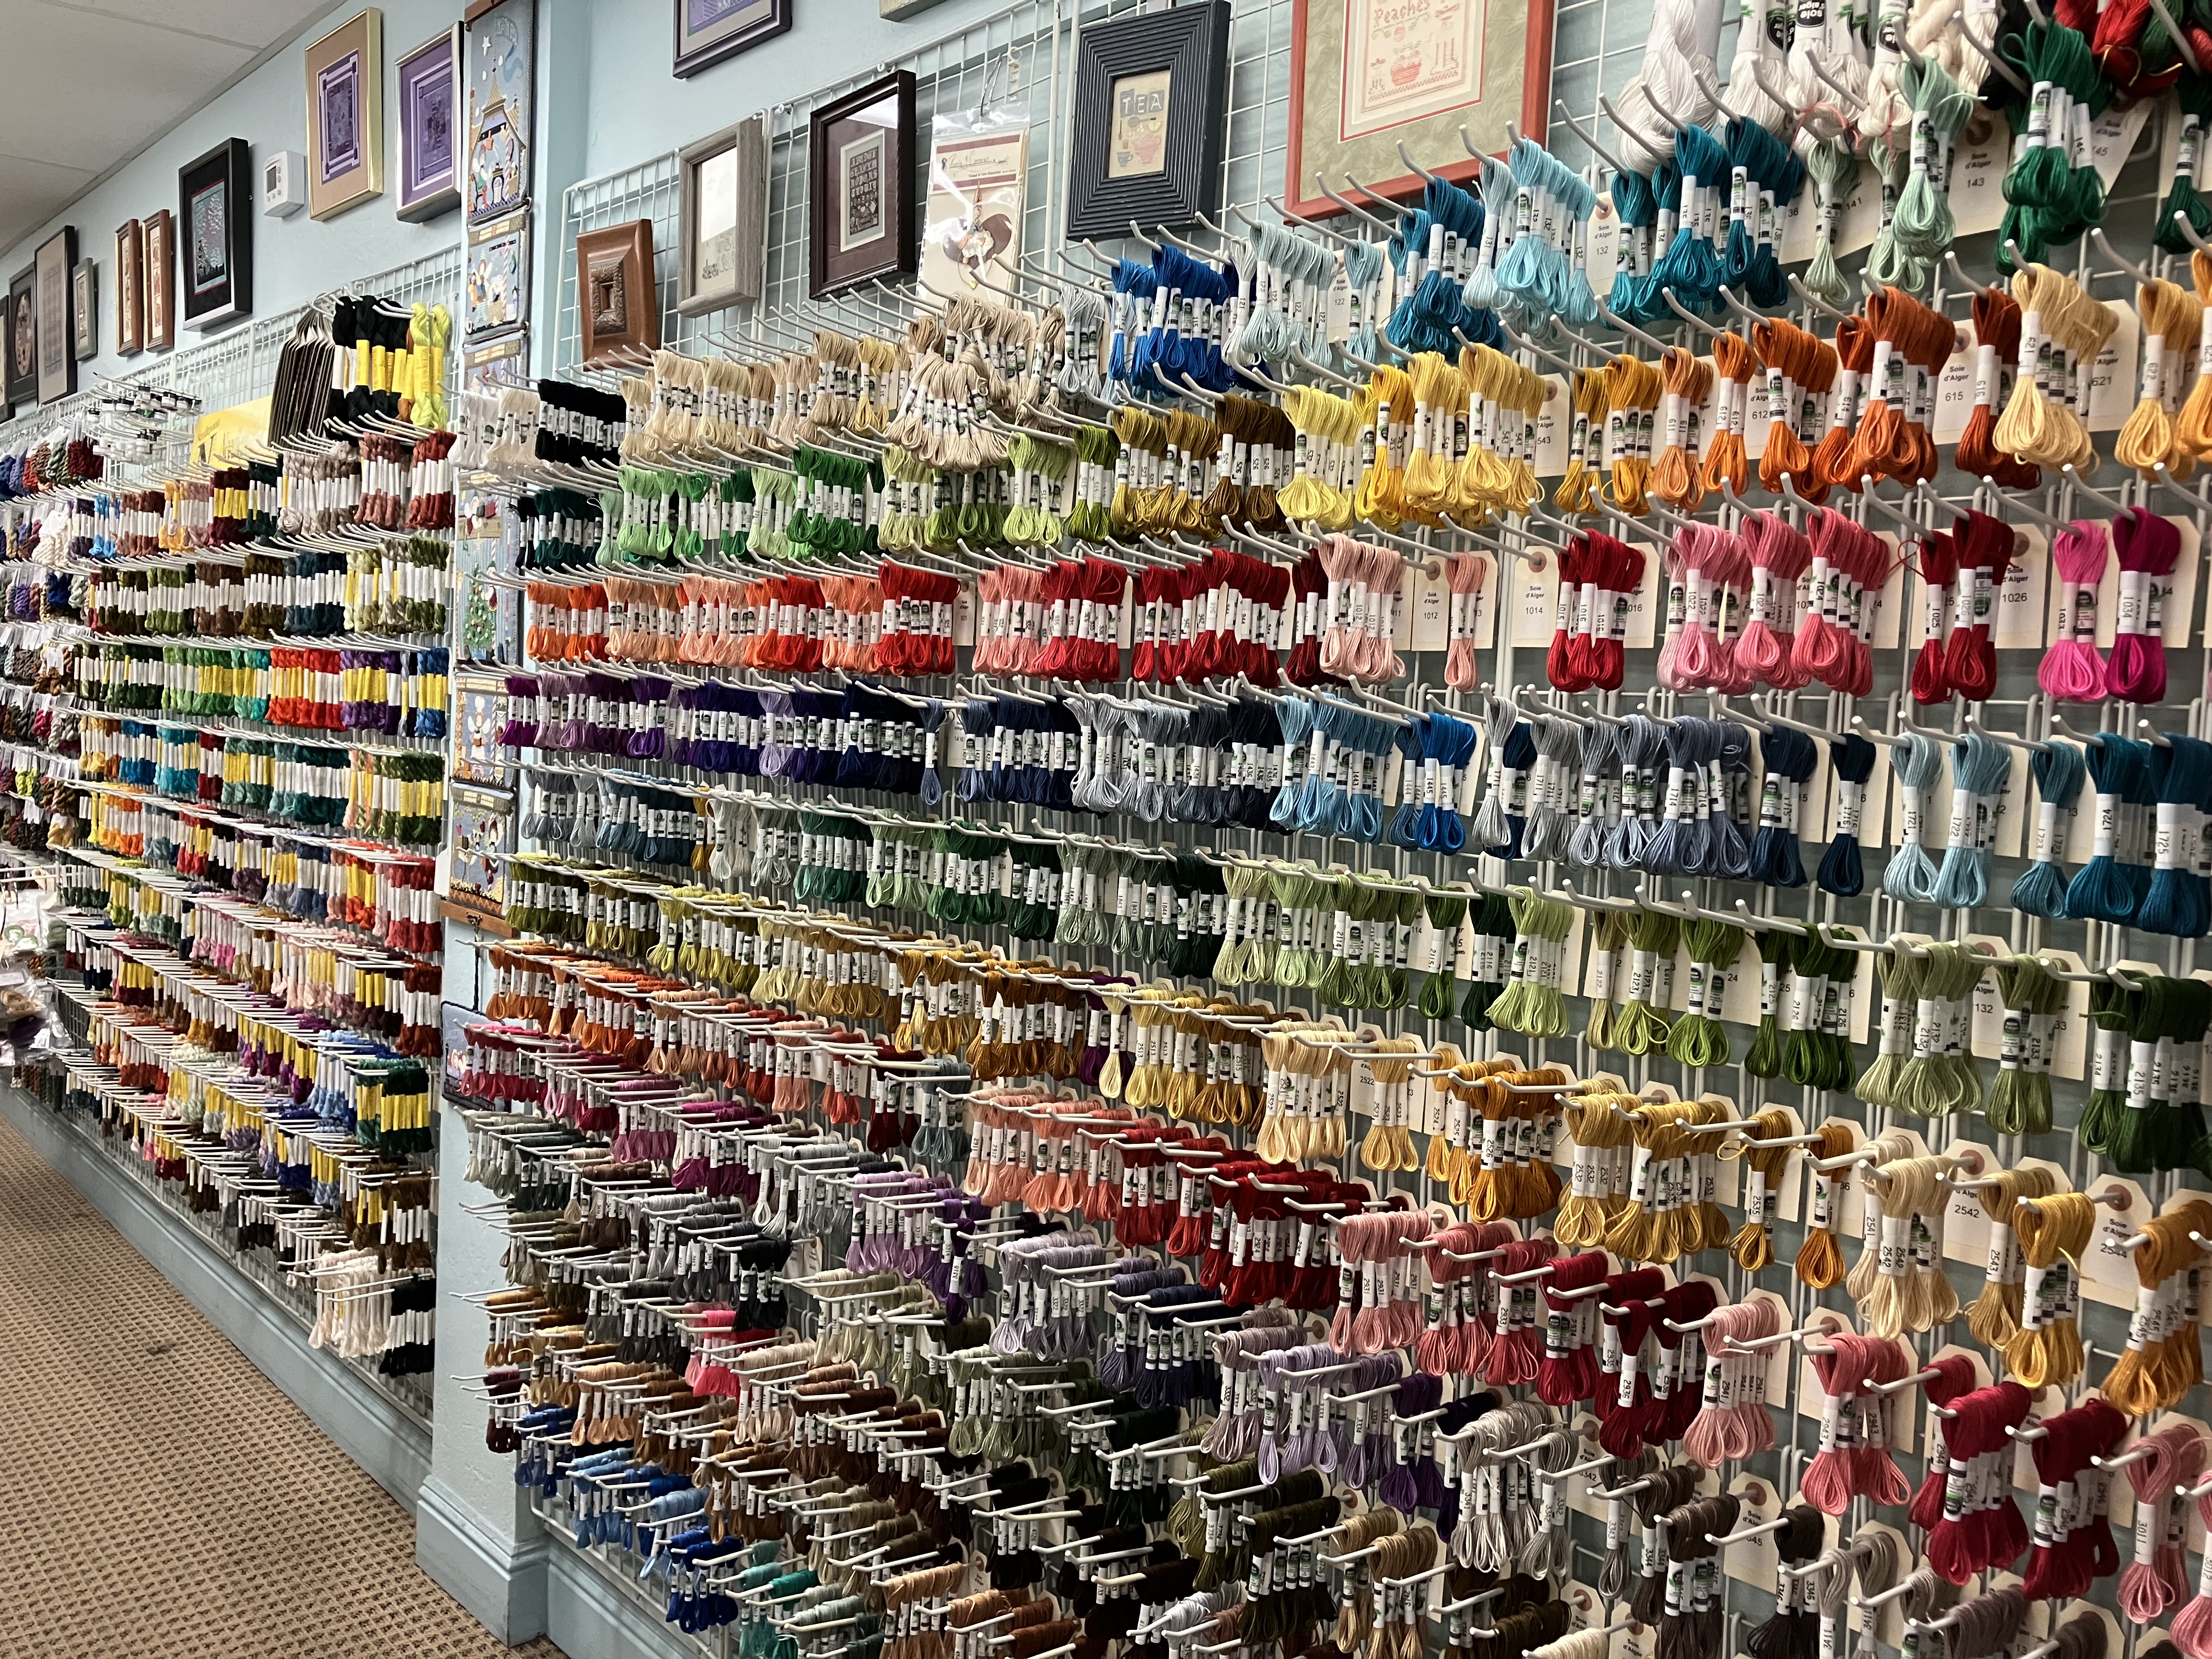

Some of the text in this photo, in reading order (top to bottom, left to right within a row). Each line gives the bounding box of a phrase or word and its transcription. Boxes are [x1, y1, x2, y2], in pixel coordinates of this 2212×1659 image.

[1122, 93, 1161, 114] TEA
[1967, 177, 1984, 188] 143
[1594, 230, 1612, 239] d'Alger
[1596, 246, 1609, 255] 132
[1944, 373, 1969, 382] d'Alger
[1945, 392, 1964, 401] 615
[1752, 410, 1767, 419] 612
[1538, 436, 1551, 445] 543
[1816, 582, 1824, 600] 1024
[2002, 593, 2027, 603] 1026
[1526, 606, 1543, 614] 1014
[1960, 595, 1970, 616] 1026
[2122, 596, 2133, 618] 1034
[1842, 806, 1852, 828] 1716
[1908, 811, 1917, 831] 1721
[2103, 809, 2112, 831] 1724
[1951, 818, 1962, 837] 1722
[1631, 973, 1641, 993] 2123
[1922, 1026, 1930, 1049] 2132
[1575, 1165, 1584, 1182] 2532
[1586, 1165, 1595, 1183] 2532
[1600, 1167, 1609, 1185] 2532
[1752, 1195, 1760, 1215] 2535
[1955, 1205, 1979, 1218] 2542
[1867, 1217, 1876, 1235] 2541
[1882, 1246, 1892, 1268] 2542
[1990, 1250, 1999, 1273] 2543
[1623, 1380, 1632, 1398] 2936
[1544, 1503, 1553, 1522] 3342
